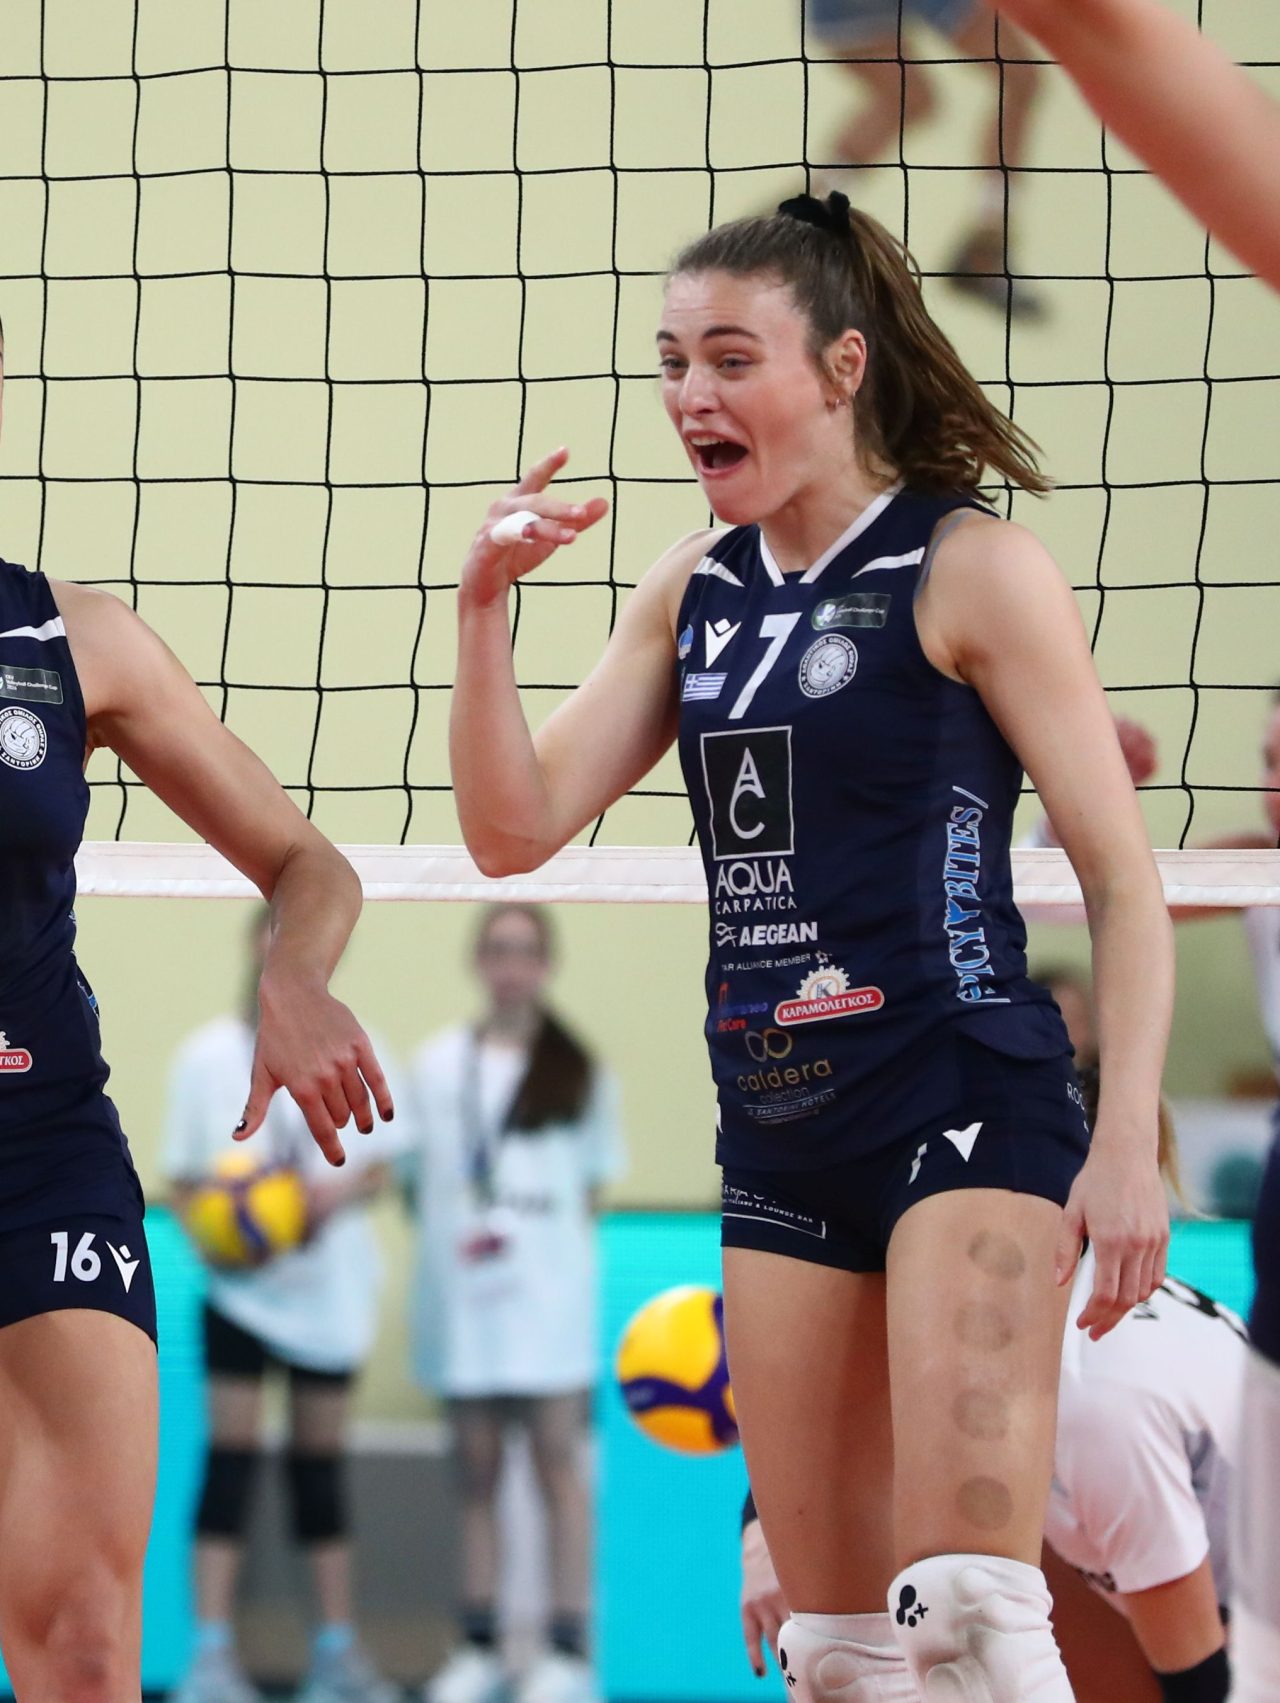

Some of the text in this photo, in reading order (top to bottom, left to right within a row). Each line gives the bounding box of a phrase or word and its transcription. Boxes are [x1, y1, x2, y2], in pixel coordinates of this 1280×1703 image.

[728, 612, 802, 719] 7
[943, 806, 984, 901] BITES
[715, 859, 794, 898] AQUA
[715, 896, 797, 914] CARPATICA
[739, 921, 818, 947] AEGEAN
[775, 953, 811, 967] MEMBER
[782, 993, 875, 1019] ΚΑΡΑΜΟΛΕΓΚΟΣ
[737, 1059, 833, 1092] caldera
[50, 1231, 101, 1282] 16
